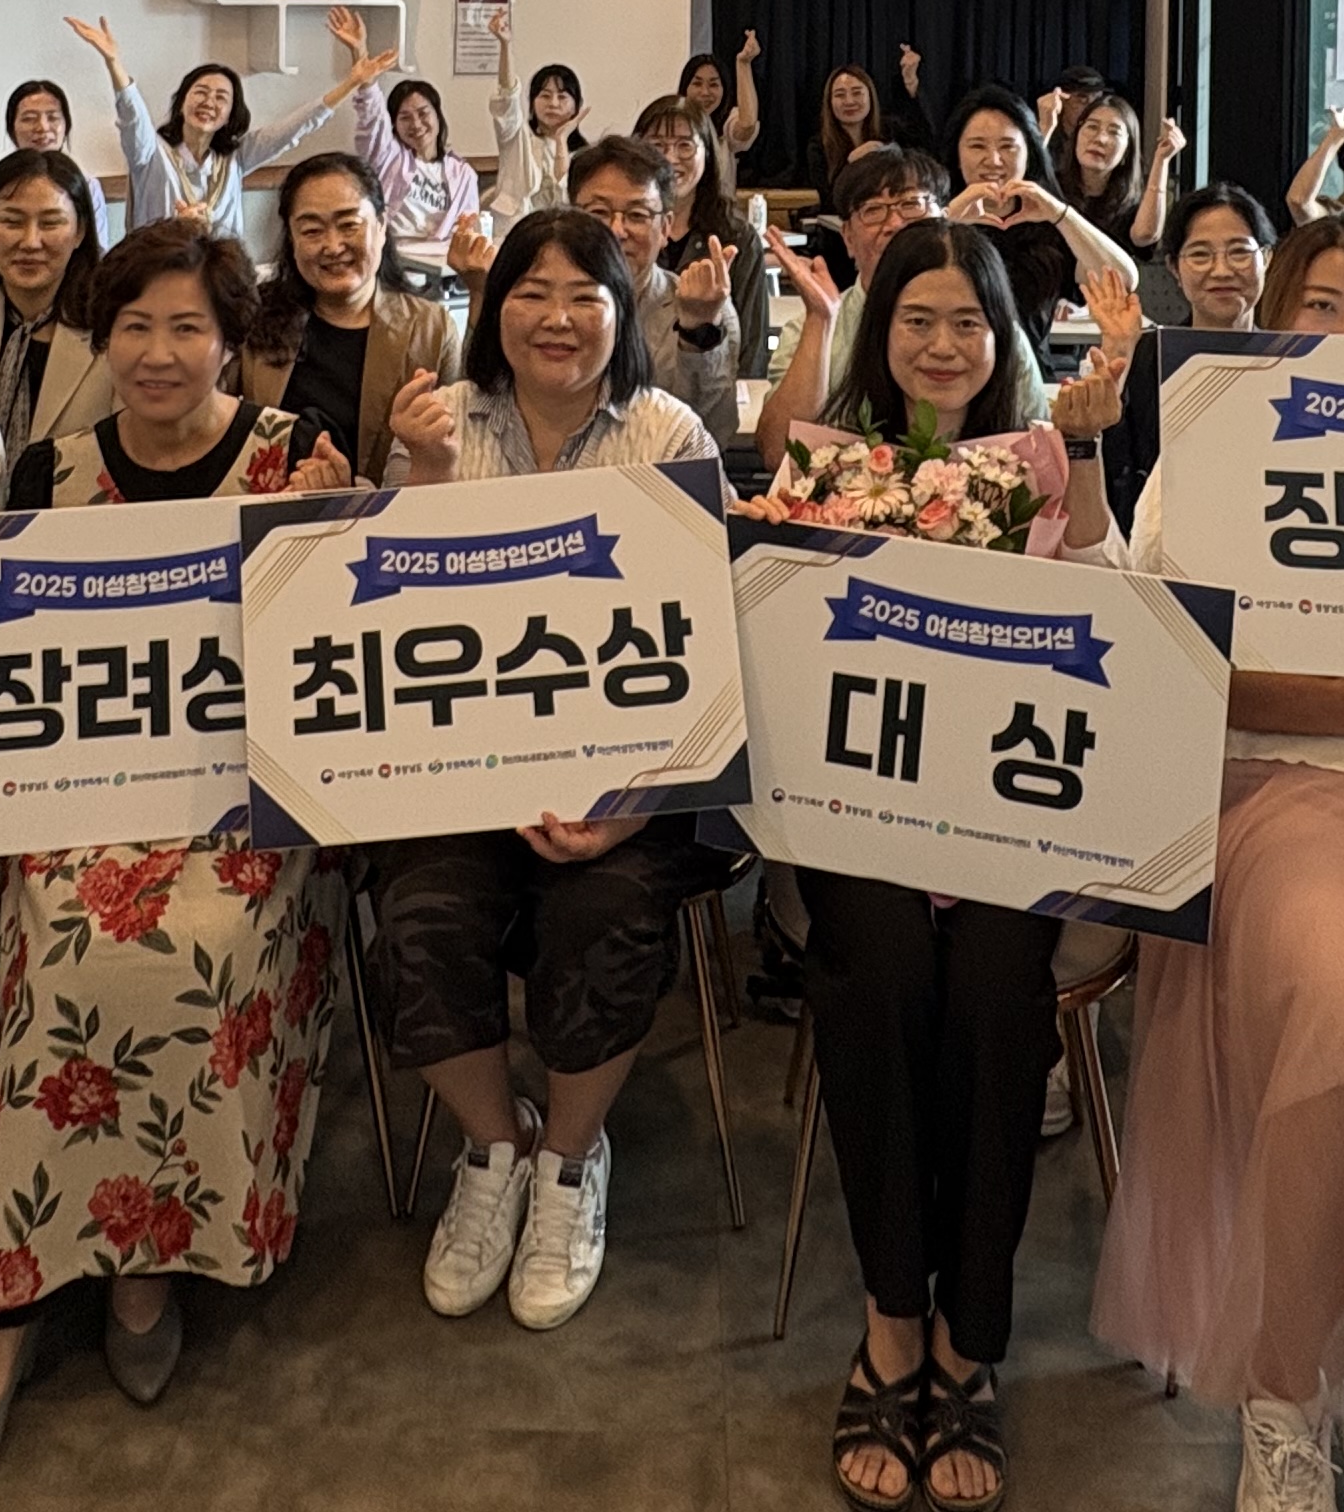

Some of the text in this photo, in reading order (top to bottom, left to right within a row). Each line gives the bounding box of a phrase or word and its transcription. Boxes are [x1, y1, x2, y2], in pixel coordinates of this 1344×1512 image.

[14, 555, 228, 600] 2025 여성창업오디션
[379, 529, 586, 577] 2025 여성창업오디션
[858, 594, 1076, 652] 2025 여성창업오디션
[292, 600, 694, 737] 최우수상
[824, 670, 1097, 811] 대 상
